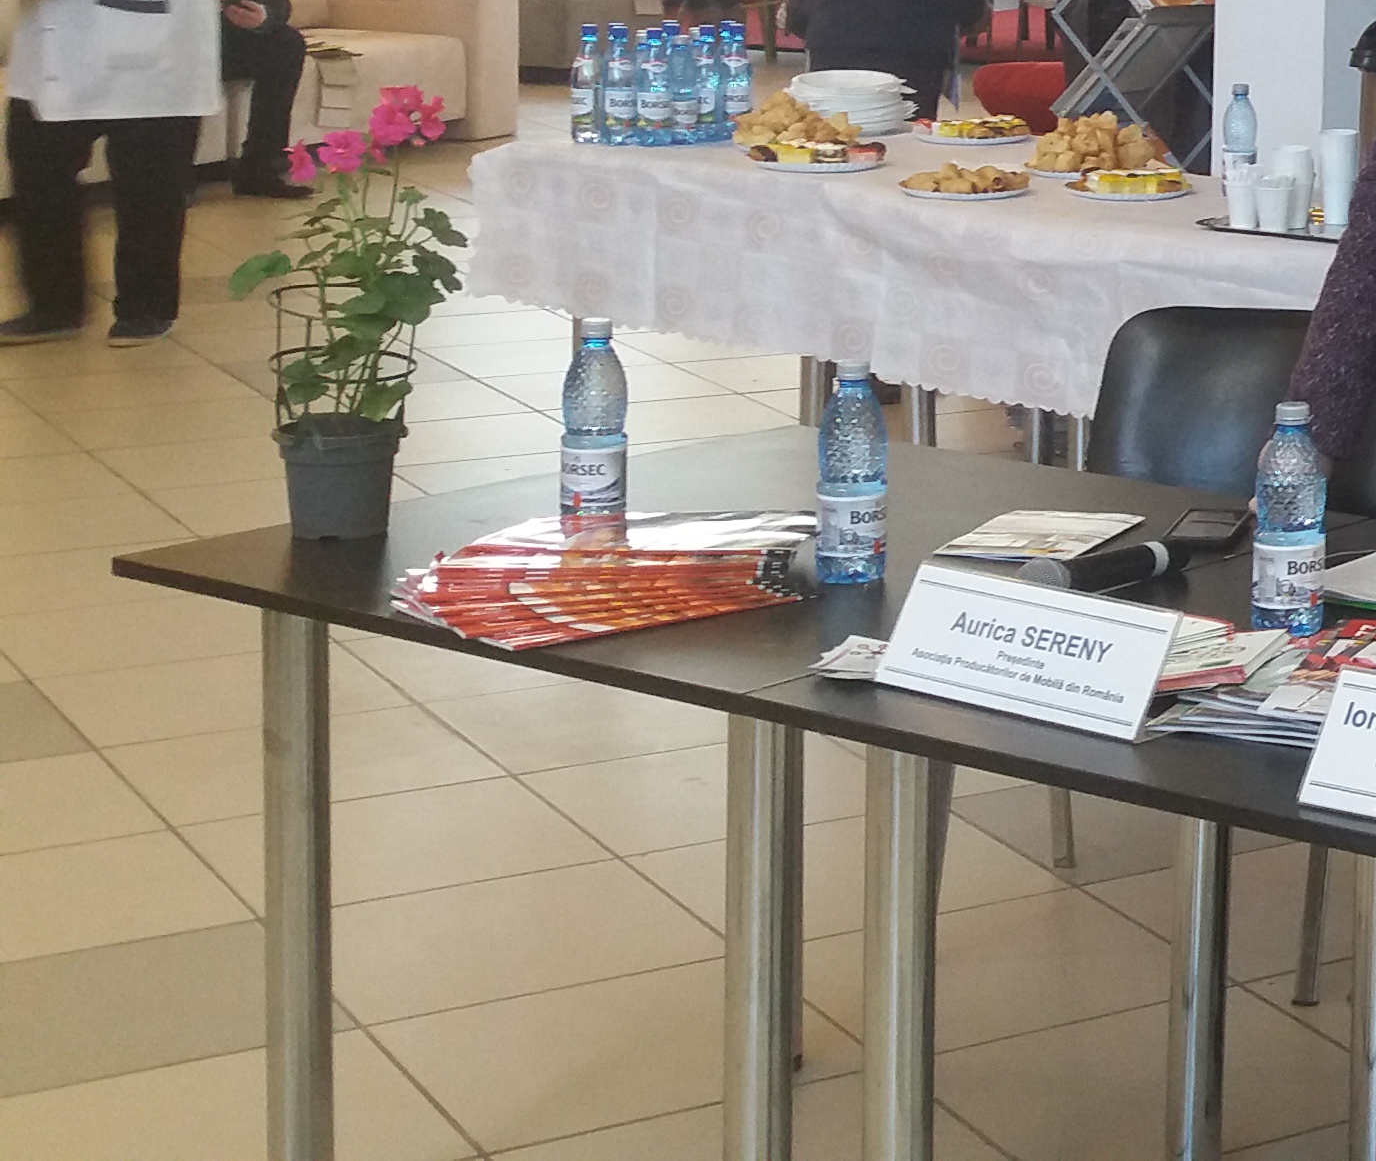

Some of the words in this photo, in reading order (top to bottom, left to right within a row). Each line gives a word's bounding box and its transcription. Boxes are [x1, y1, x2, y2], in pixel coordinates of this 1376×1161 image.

[850, 506, 888, 525] BORS
[1287, 560, 1323, 576] BORS
[950, 612, 1016, 644] Aurica
[1021, 626, 1114, 663] SERENY
[953, 656, 1019, 679] Producătorilor
[1019, 672, 1032, 683] de
[1032, 674, 1065, 690] Mobilă
[1065, 682, 1081, 694] din
[1081, 685, 1124, 704] România
